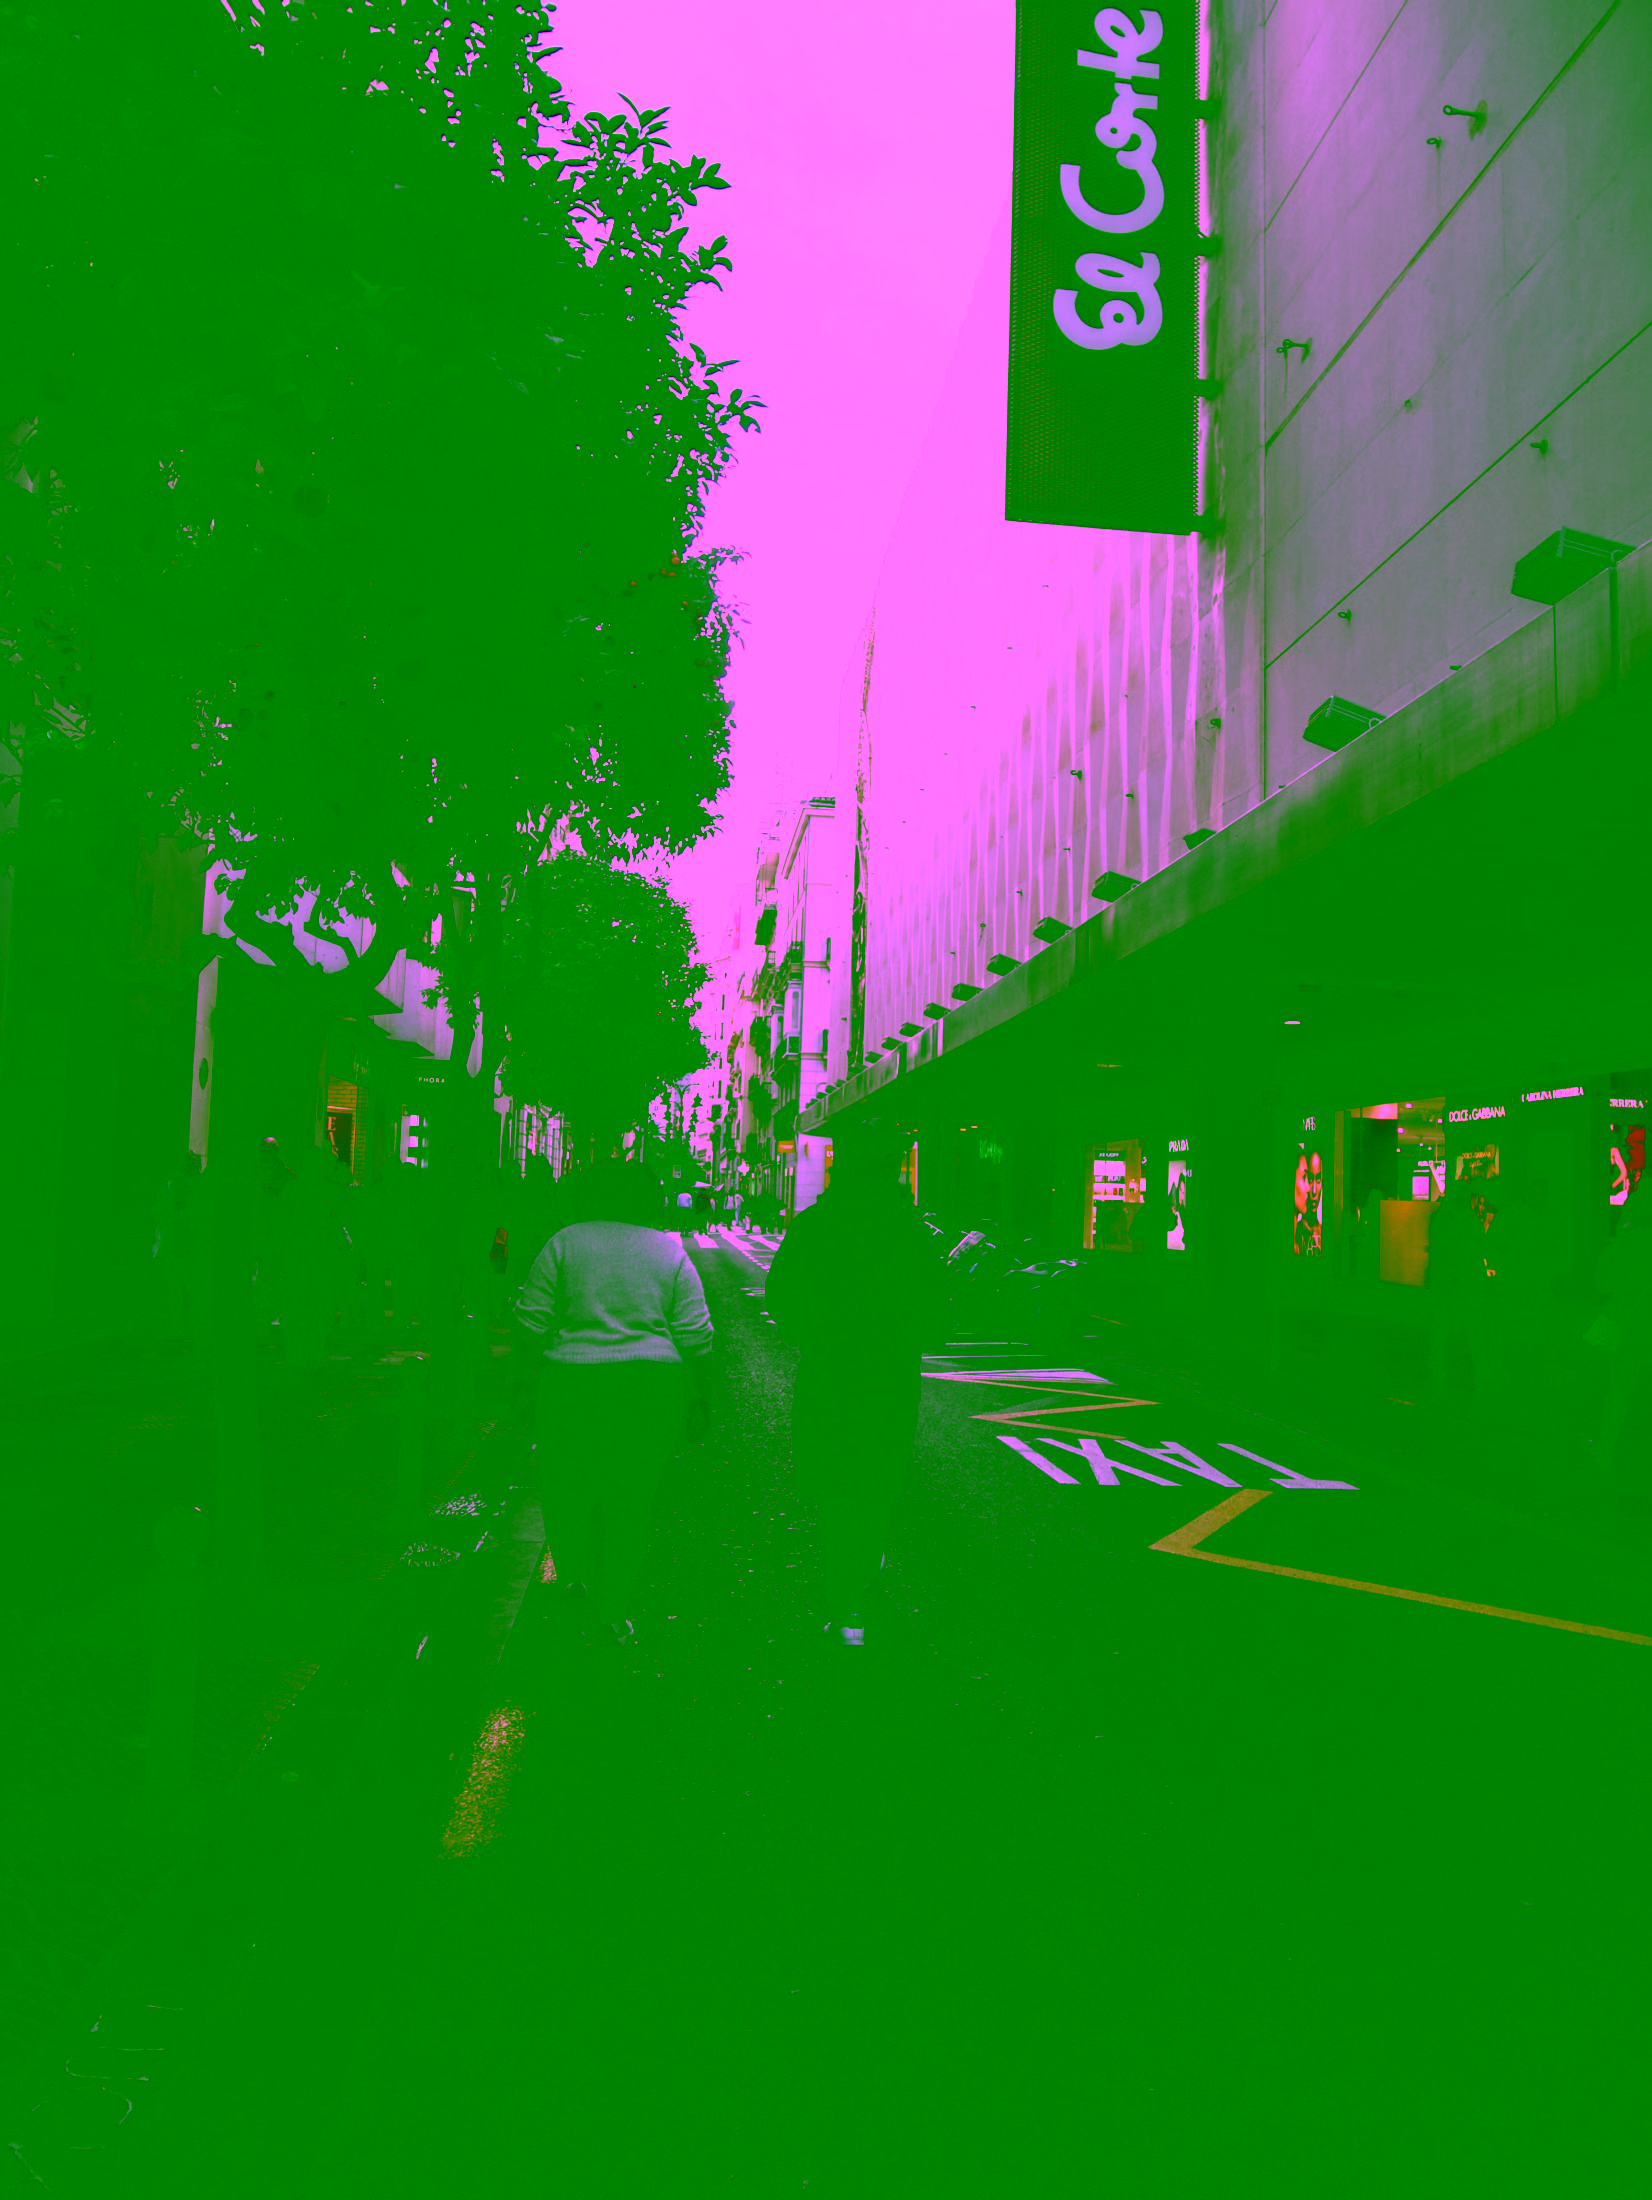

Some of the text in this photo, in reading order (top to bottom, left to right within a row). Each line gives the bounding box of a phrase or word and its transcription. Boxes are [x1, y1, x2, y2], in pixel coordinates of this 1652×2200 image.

[1053, 8, 1164, 350] El Corte
[996, 1436, 1360, 1490] TAXI
